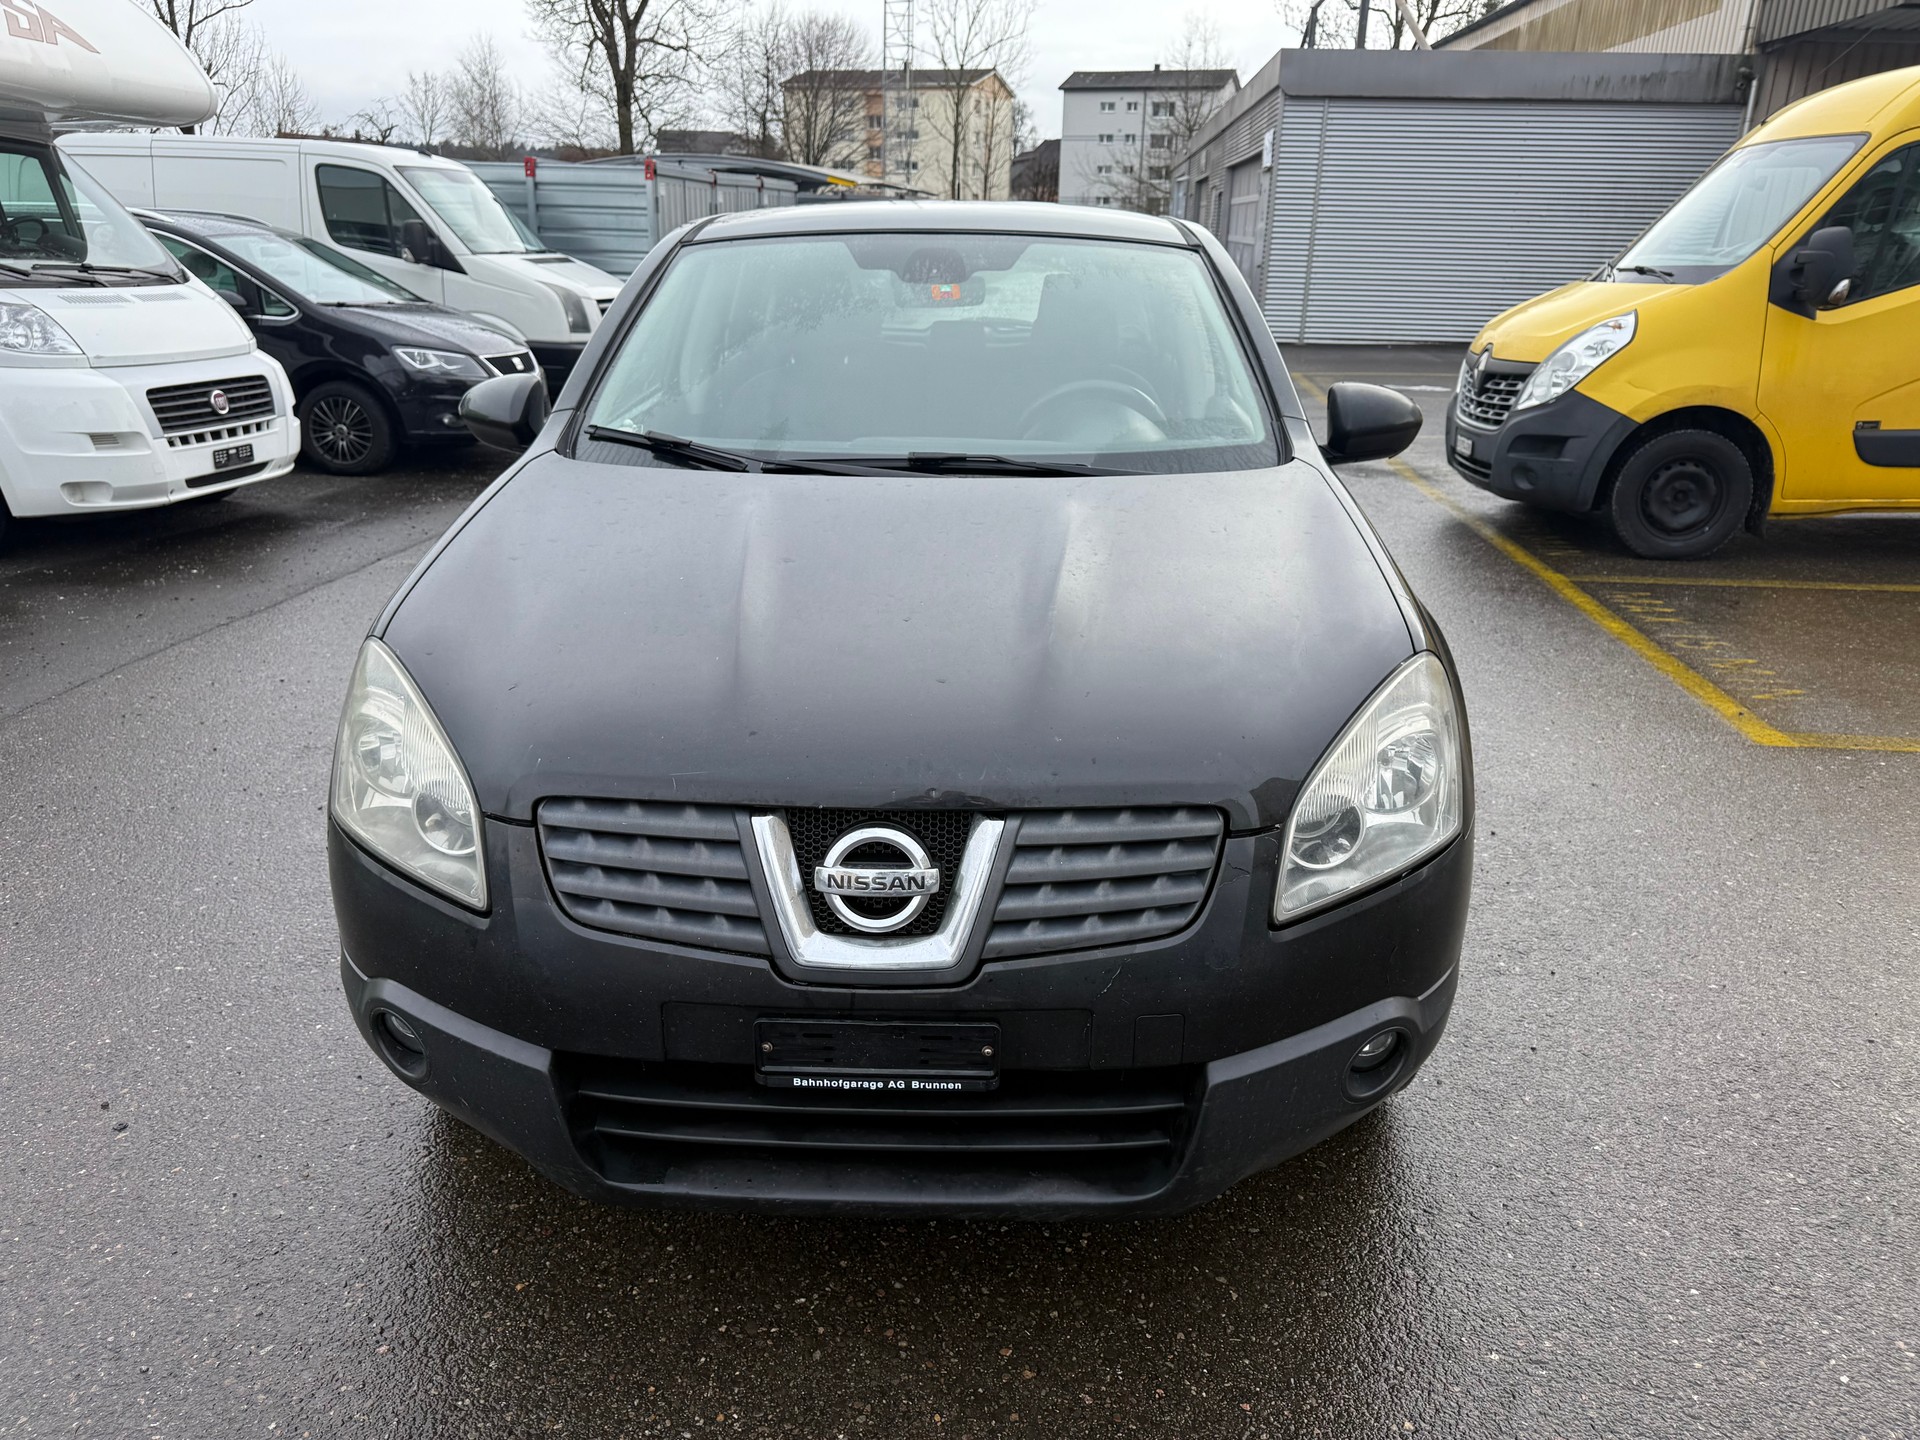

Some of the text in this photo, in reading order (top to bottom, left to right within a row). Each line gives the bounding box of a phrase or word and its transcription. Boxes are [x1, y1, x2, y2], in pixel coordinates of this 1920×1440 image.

[827, 873, 925, 891] NISSAN
[793, 1077, 962, 1090] Bahnhofgarage AG Brunnen
